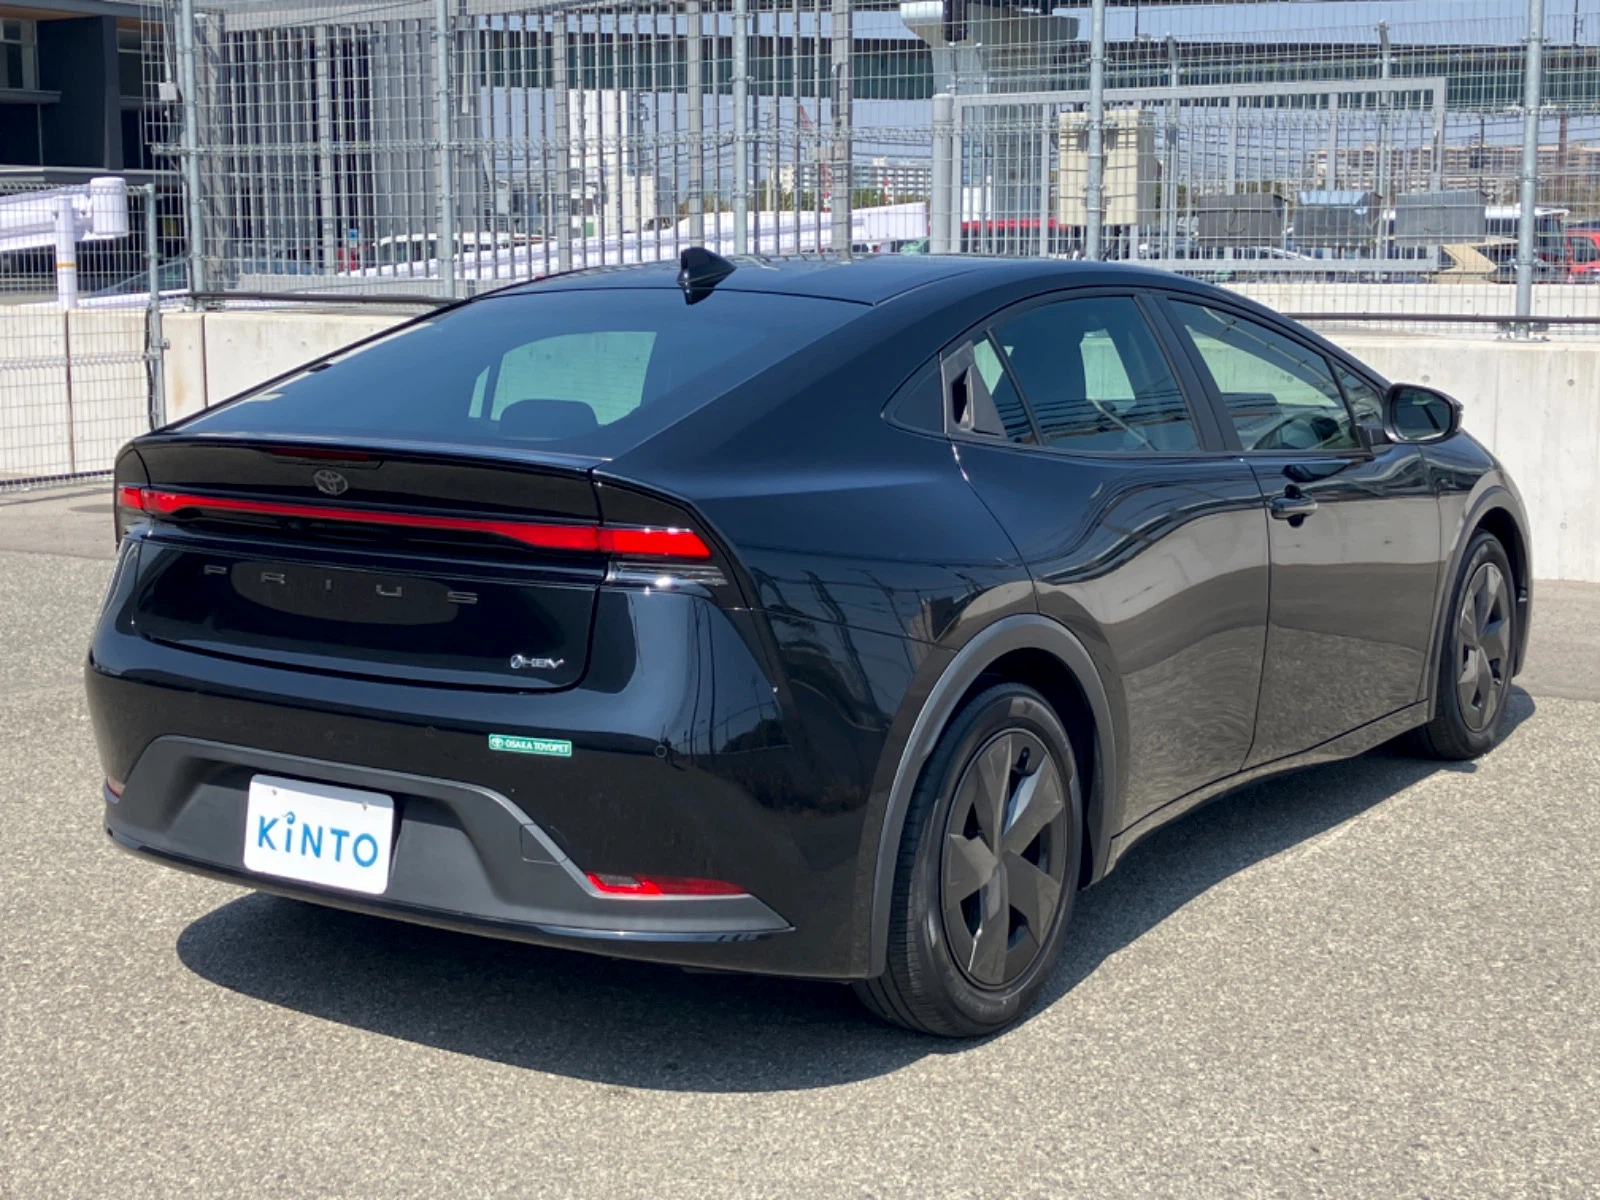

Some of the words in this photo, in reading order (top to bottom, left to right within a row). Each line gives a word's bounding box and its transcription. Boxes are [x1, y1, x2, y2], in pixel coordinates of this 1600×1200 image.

[203, 564, 478, 604] PRIUS
[505, 740, 532, 750] OSAKA
[533, 742, 569, 753] TOYOPET
